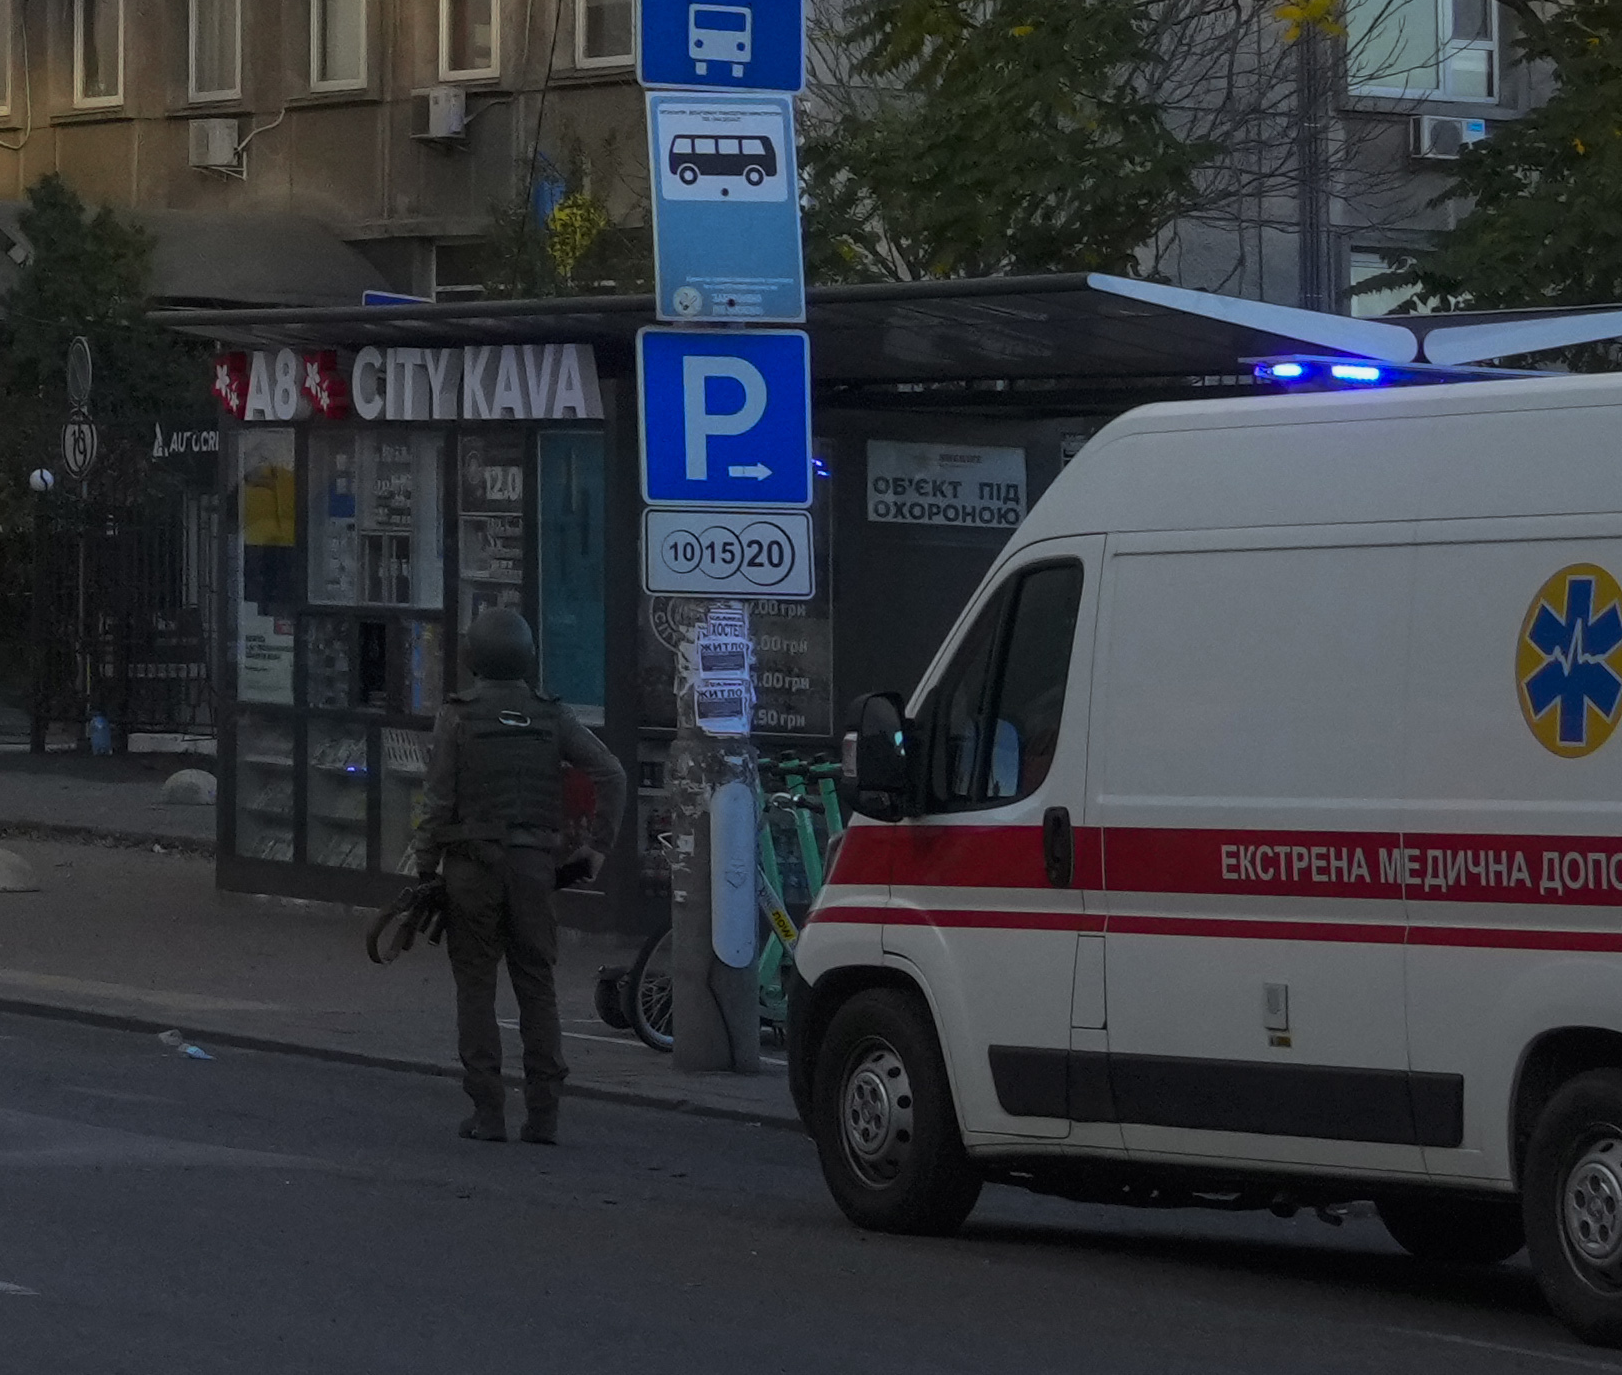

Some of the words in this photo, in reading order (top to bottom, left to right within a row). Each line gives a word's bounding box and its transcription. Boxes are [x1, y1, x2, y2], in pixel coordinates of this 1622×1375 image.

[351, 346, 455, 421] CITY
[463, 344, 598, 420] KAVA
[683, 355, 767, 481] P
[873, 475, 962, 499] ОБ'ЄКТ
[979, 481, 1020, 505] ПІД
[874, 502, 1020, 525] ОХОРОНОЮ
[669, 541, 695, 562] 10
[705, 541, 736, 564] 15
[746, 539, 784, 568] 20
[700, 641, 745, 652] ЖИТЛО
[697, 688, 743, 699] ЖИТЛО
[1221, 844, 1371, 884] ЕКСТРЕНА
[1379, 847, 1532, 893] МЕДИЧНА
